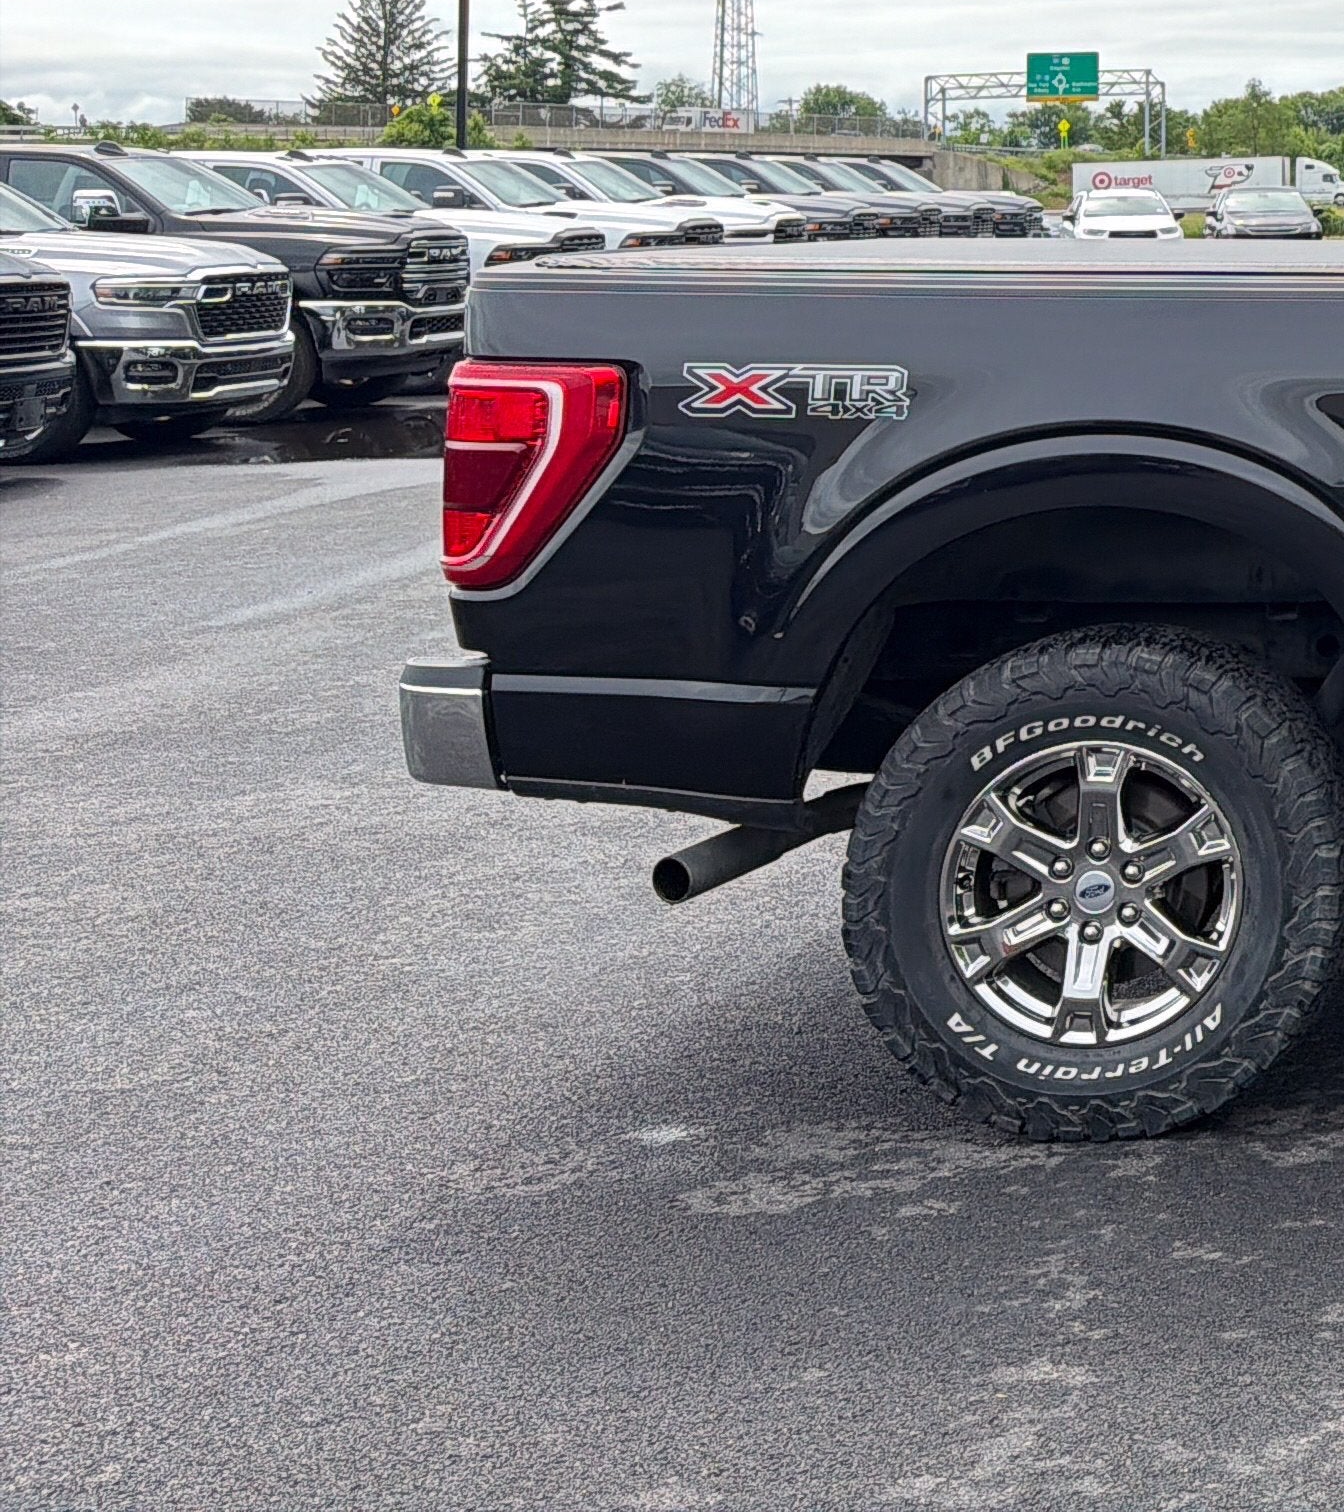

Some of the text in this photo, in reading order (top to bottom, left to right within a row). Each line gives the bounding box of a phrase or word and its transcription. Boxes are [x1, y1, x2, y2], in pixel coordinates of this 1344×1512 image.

[703, 111, 740, 129] FedEx
[1114, 174, 1153, 189] target
[678, 362, 911, 419] XTR
[969, 713, 1206, 774] BFGoodrich
[1084, 886, 1105, 899] Ford
[946, 1001, 1224, 1082] All-Terrain T/A
